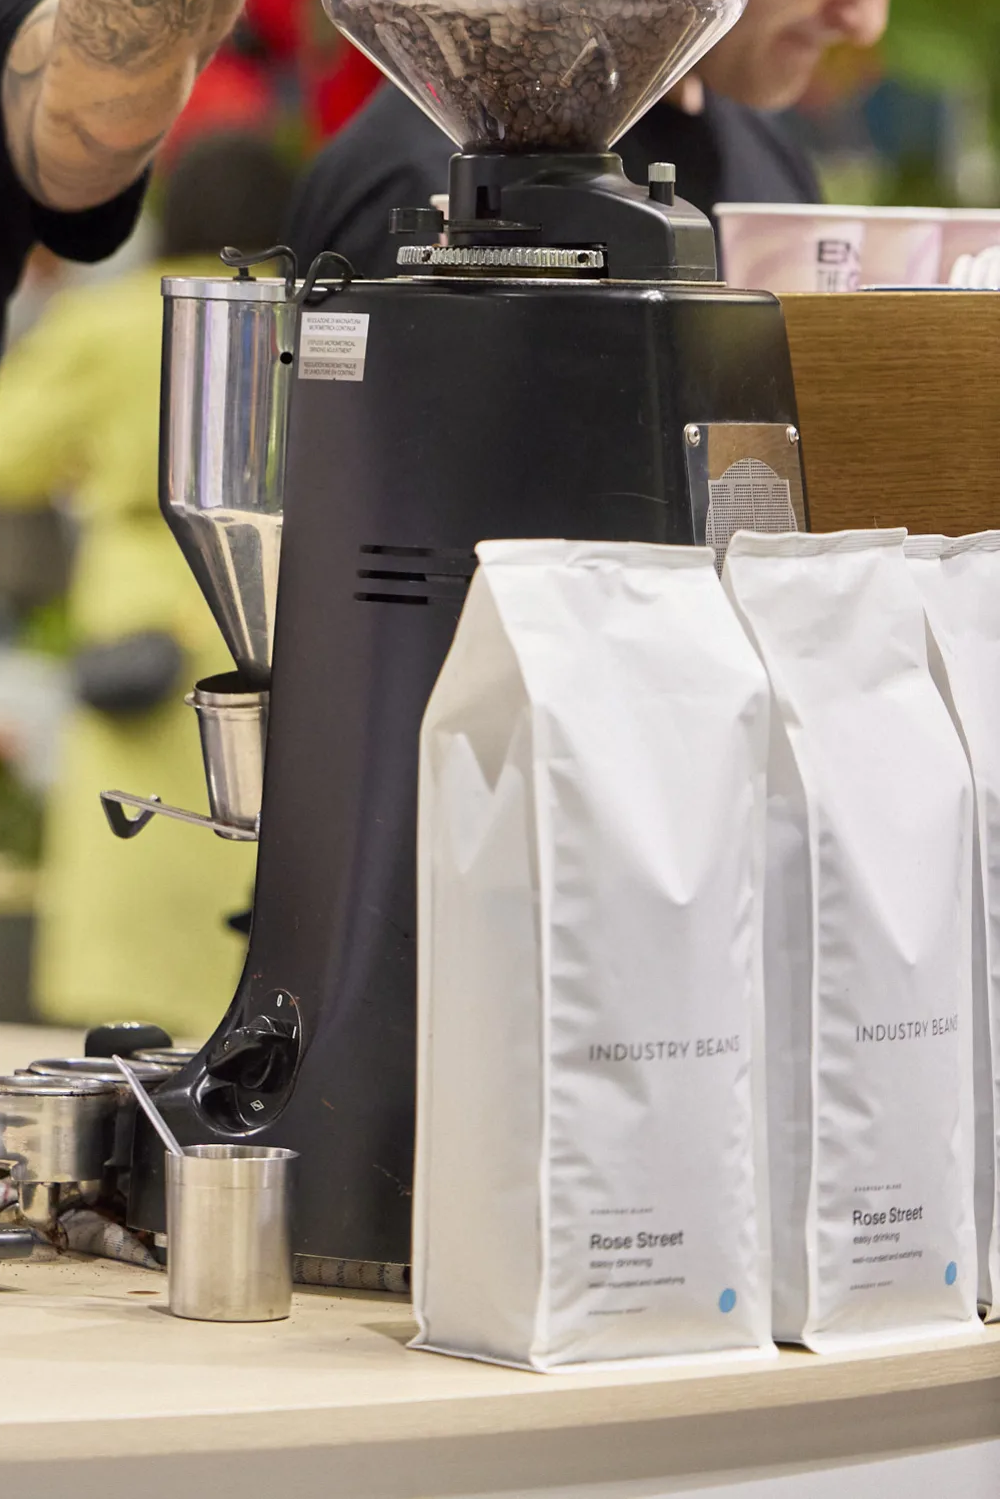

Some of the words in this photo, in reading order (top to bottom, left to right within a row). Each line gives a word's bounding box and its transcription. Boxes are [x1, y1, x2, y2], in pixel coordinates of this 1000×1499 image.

[856, 1020, 929, 1043] INDUSTRY
[589, 1040, 691, 1062] INDUSTRY
[695, 1034, 741, 1058] BEANS
[852, 1208, 887, 1227] Rose
[889, 1204, 924, 1224] Street
[589, 1232, 633, 1251] Rose
[636, 1229, 684, 1250] Street
[852, 1235, 872, 1246] easy
[872, 1231, 901, 1244] drinking
